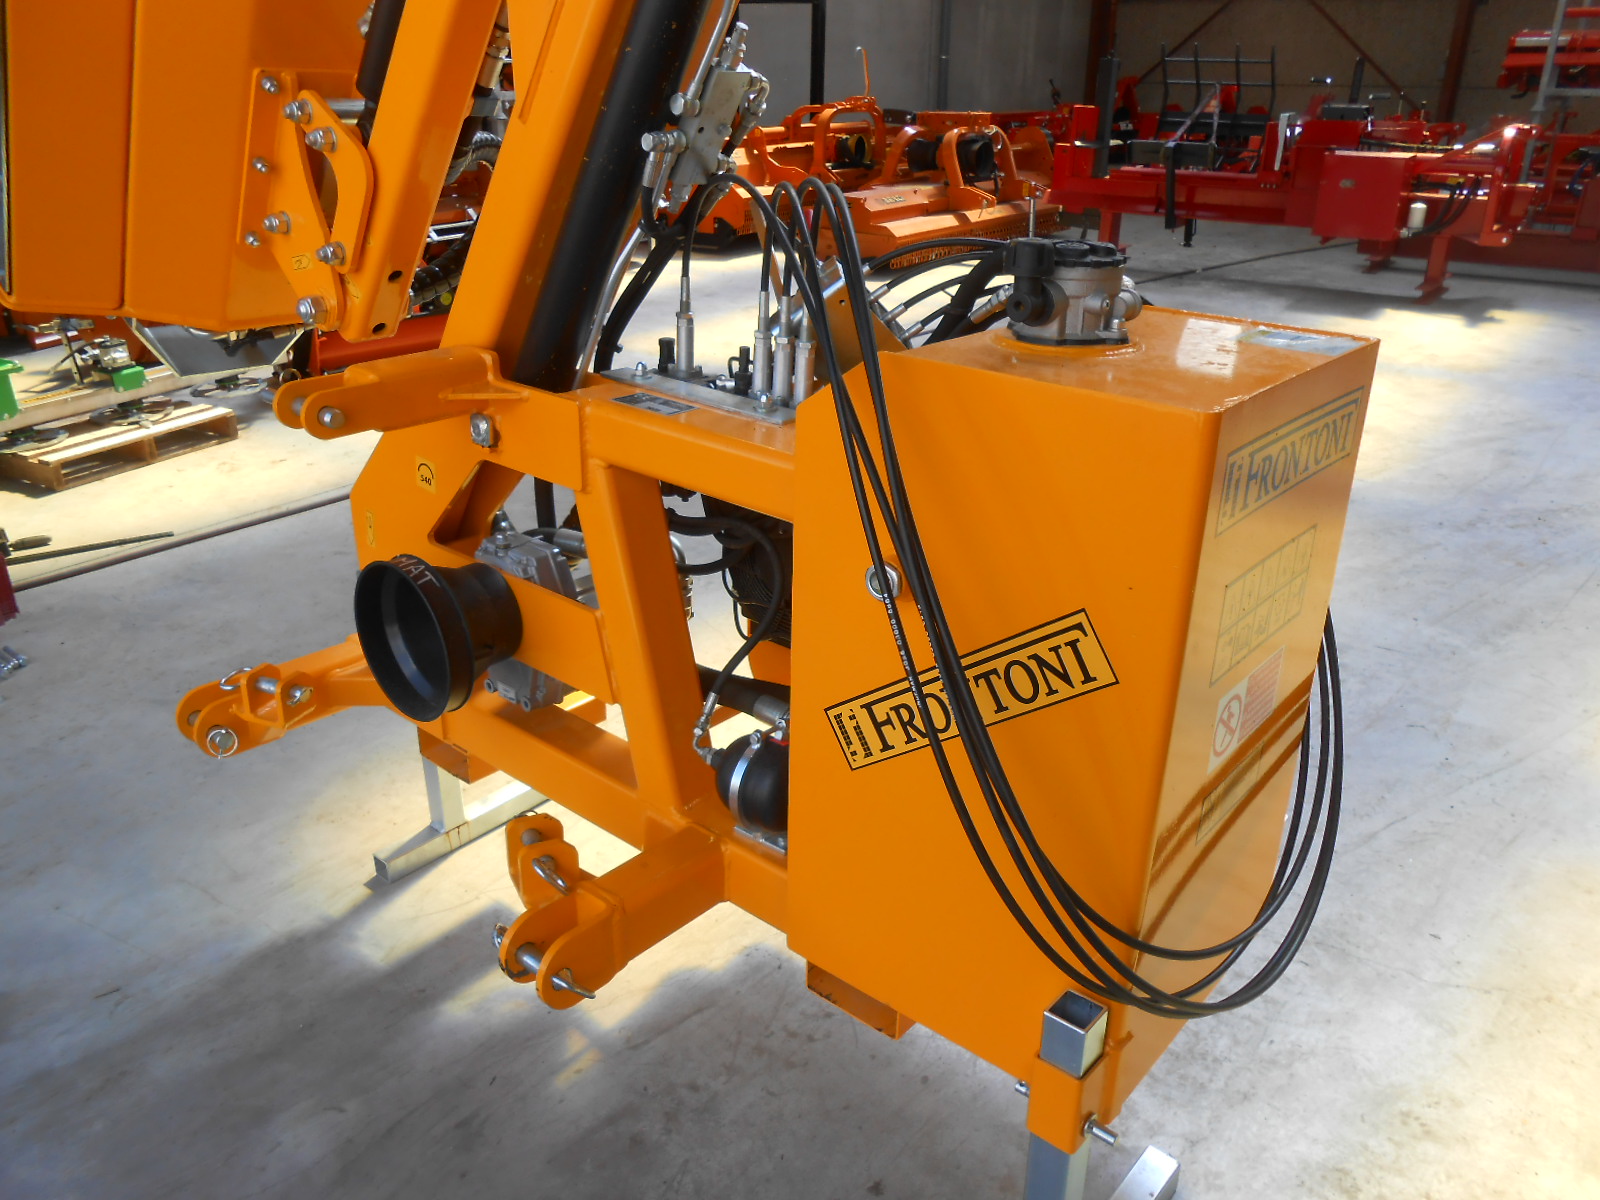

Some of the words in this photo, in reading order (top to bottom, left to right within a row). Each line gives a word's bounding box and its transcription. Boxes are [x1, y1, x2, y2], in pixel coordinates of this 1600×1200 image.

[420, 474, 432, 486] 540
[1240, 397, 1361, 513] FRONTONI
[860, 621, 1098, 754] FROTONI
